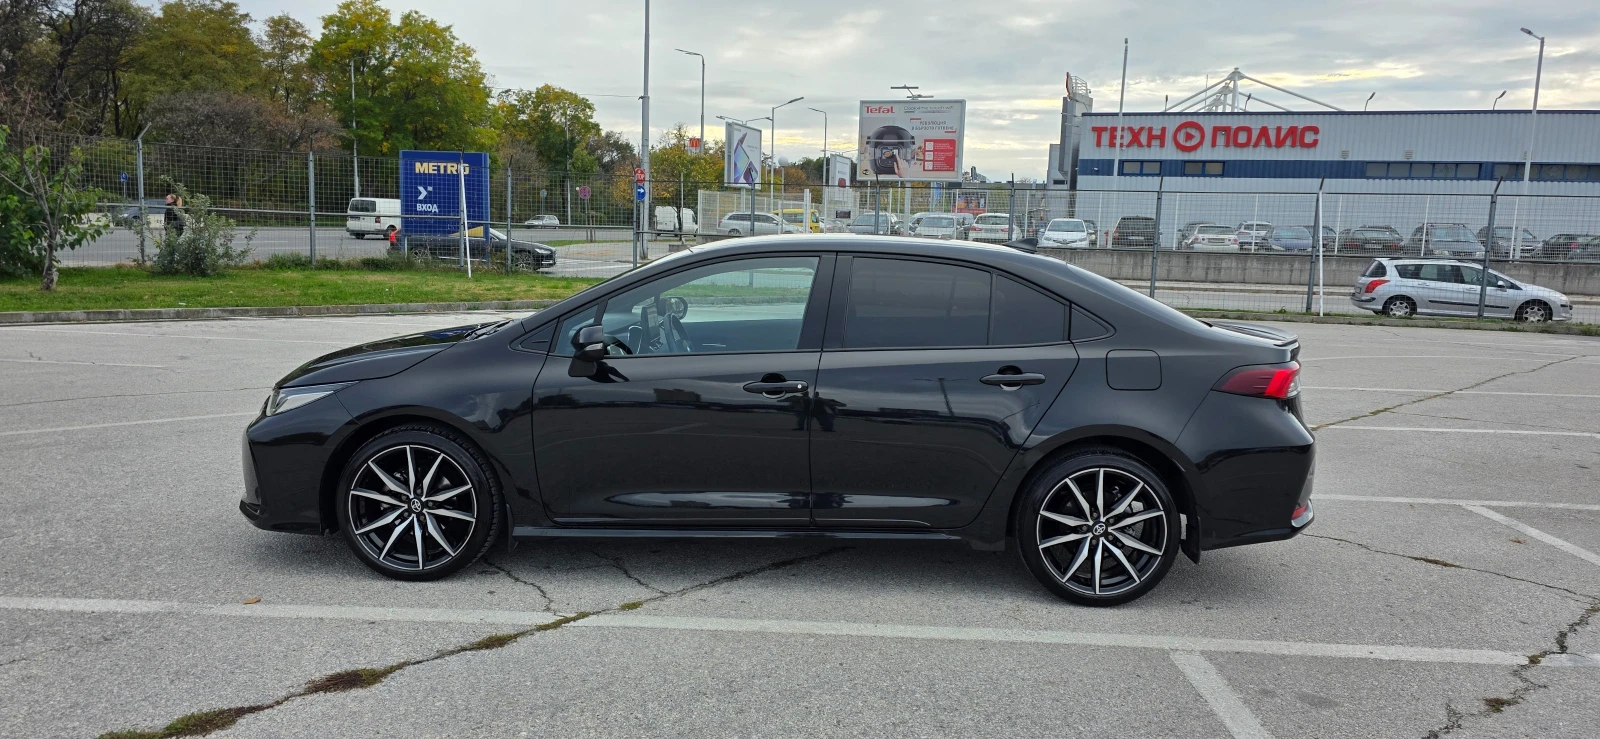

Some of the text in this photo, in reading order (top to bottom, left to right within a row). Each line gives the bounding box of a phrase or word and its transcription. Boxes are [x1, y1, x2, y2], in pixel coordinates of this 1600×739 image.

[864, 106, 895, 114] Tefal
[415, 162, 470, 174] METRO
[416, 204, 438, 213] ВХОД
